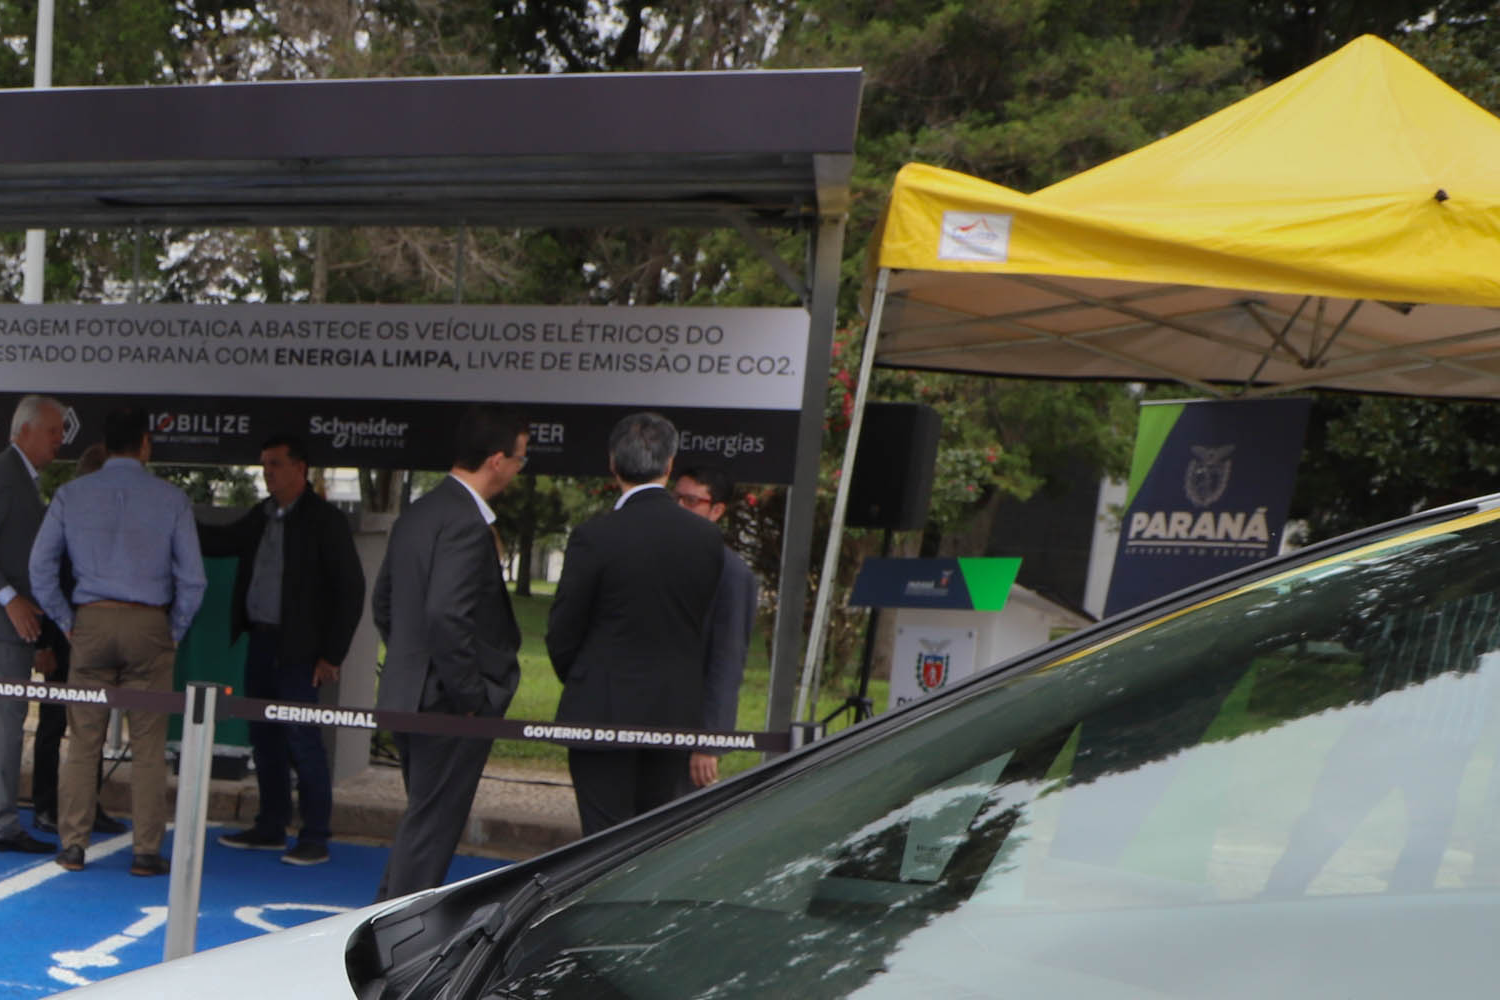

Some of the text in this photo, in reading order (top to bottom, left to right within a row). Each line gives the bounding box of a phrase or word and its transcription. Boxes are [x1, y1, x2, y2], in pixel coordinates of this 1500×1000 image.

[75, 319, 243, 338] FOTOVOLTAICA
[249, 320, 372, 339] ABASTECE
[376, 321, 409, 340] OS
[415, 316, 536, 341] VEÍCULOS
[542, 317, 679, 344] ELÉTRICOS
[686, 325, 724, 345] DO
[81, 345, 113, 363] DO
[118, 341, 211, 364] PARANÁ
[215, 346, 269, 365] COM
[274, 348, 376, 367] ENERGIA
[382, 349, 460, 371] LIMPA,
[467, 351, 535, 370] LIVRE
[540, 352, 572, 371] DE
[578, 347, 691, 373] EMISSÃO
[697, 354, 731, 374] DE
[736, 355, 796, 376] CO2.
[309, 415, 409, 437] Schneider
[680, 430, 765, 458] Energias
[1128, 506, 1269, 542] PARANÁ
[26, 685, 48, 699] DO
[49, 687, 107, 703] PARANÁ
[264, 704, 377, 728] CERIMONIAL
[523, 725, 755, 749] GOVERNO DO ESTADO DO PARANÁ
